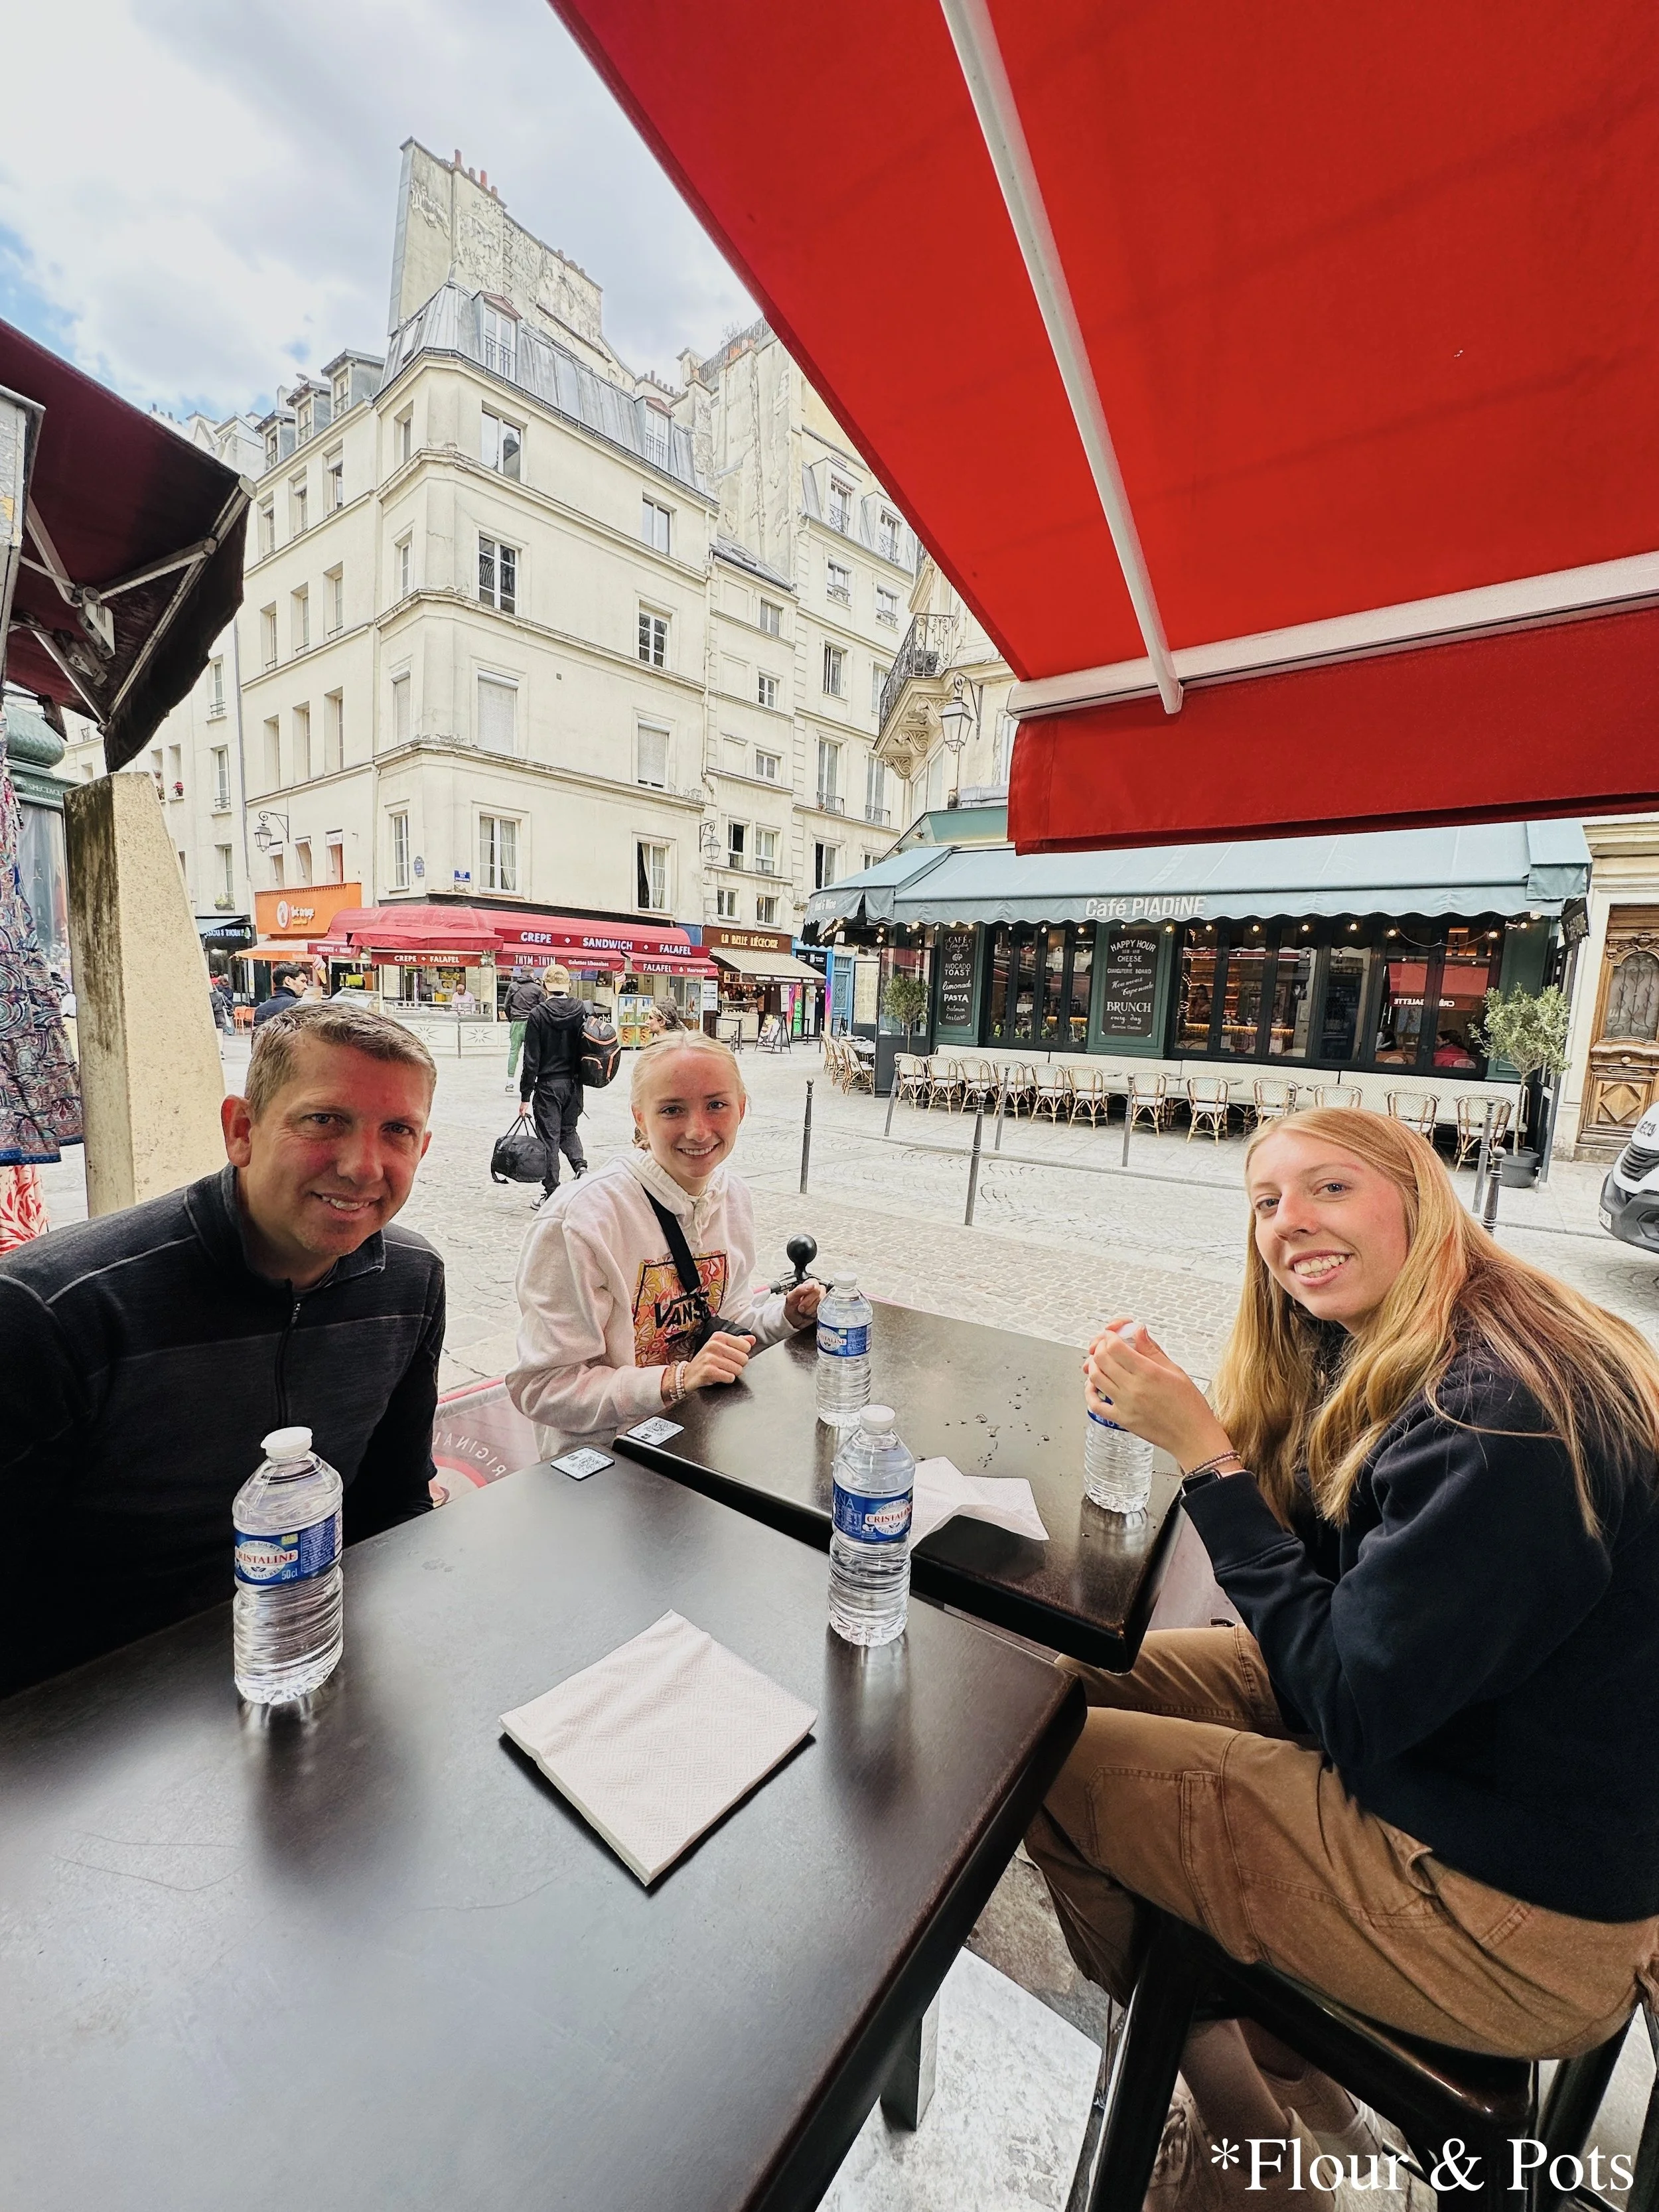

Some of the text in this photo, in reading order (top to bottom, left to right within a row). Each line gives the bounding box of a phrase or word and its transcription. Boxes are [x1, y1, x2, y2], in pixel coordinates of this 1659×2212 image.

[1085, 898, 1127, 917] Café
[520, 931, 691, 956] CREPE SANDWICH FALAFEL
[731, 934, 749, 946] BELLE
[948, 934, 968, 943] CAFÉ
[1110, 939, 1157, 952] HAPPY HOUR
[643, 963, 672, 973] FALAFEL
[944, 994, 969, 1003] PASTA
[1106, 1001, 1151, 1014] BRUNCH
[1129, 1013, 1141, 1025] day
[281, 1568, 298, 1581] 50cl
